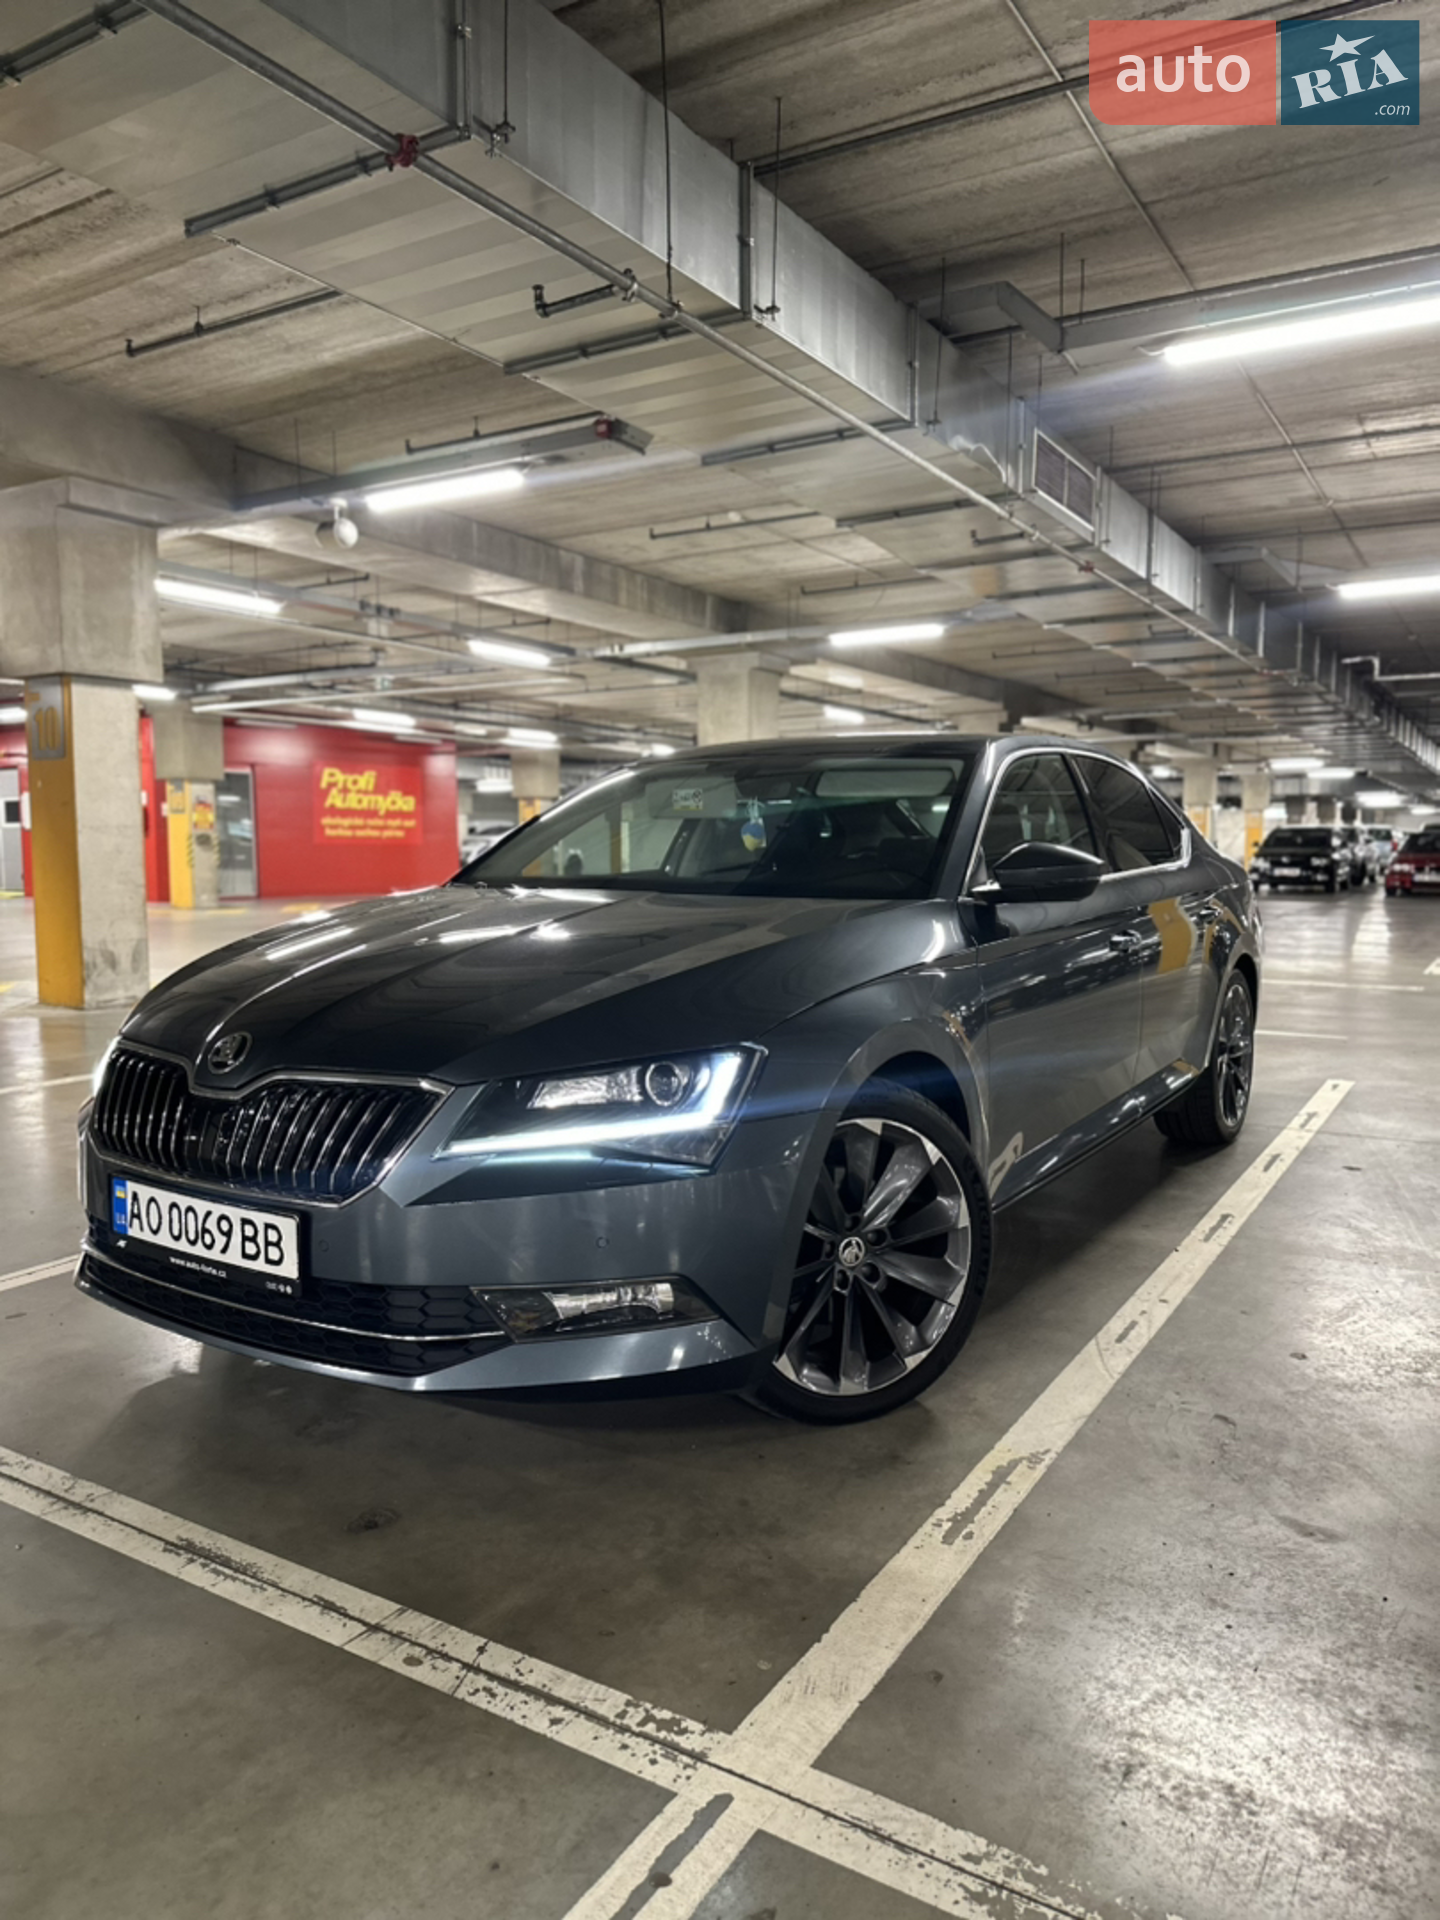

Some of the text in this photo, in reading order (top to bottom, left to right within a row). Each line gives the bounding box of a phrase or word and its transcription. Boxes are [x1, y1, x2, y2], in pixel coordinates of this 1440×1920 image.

[320, 768, 377, 792] Profi
[129, 1191, 284, 1266] AO 0069 BB
